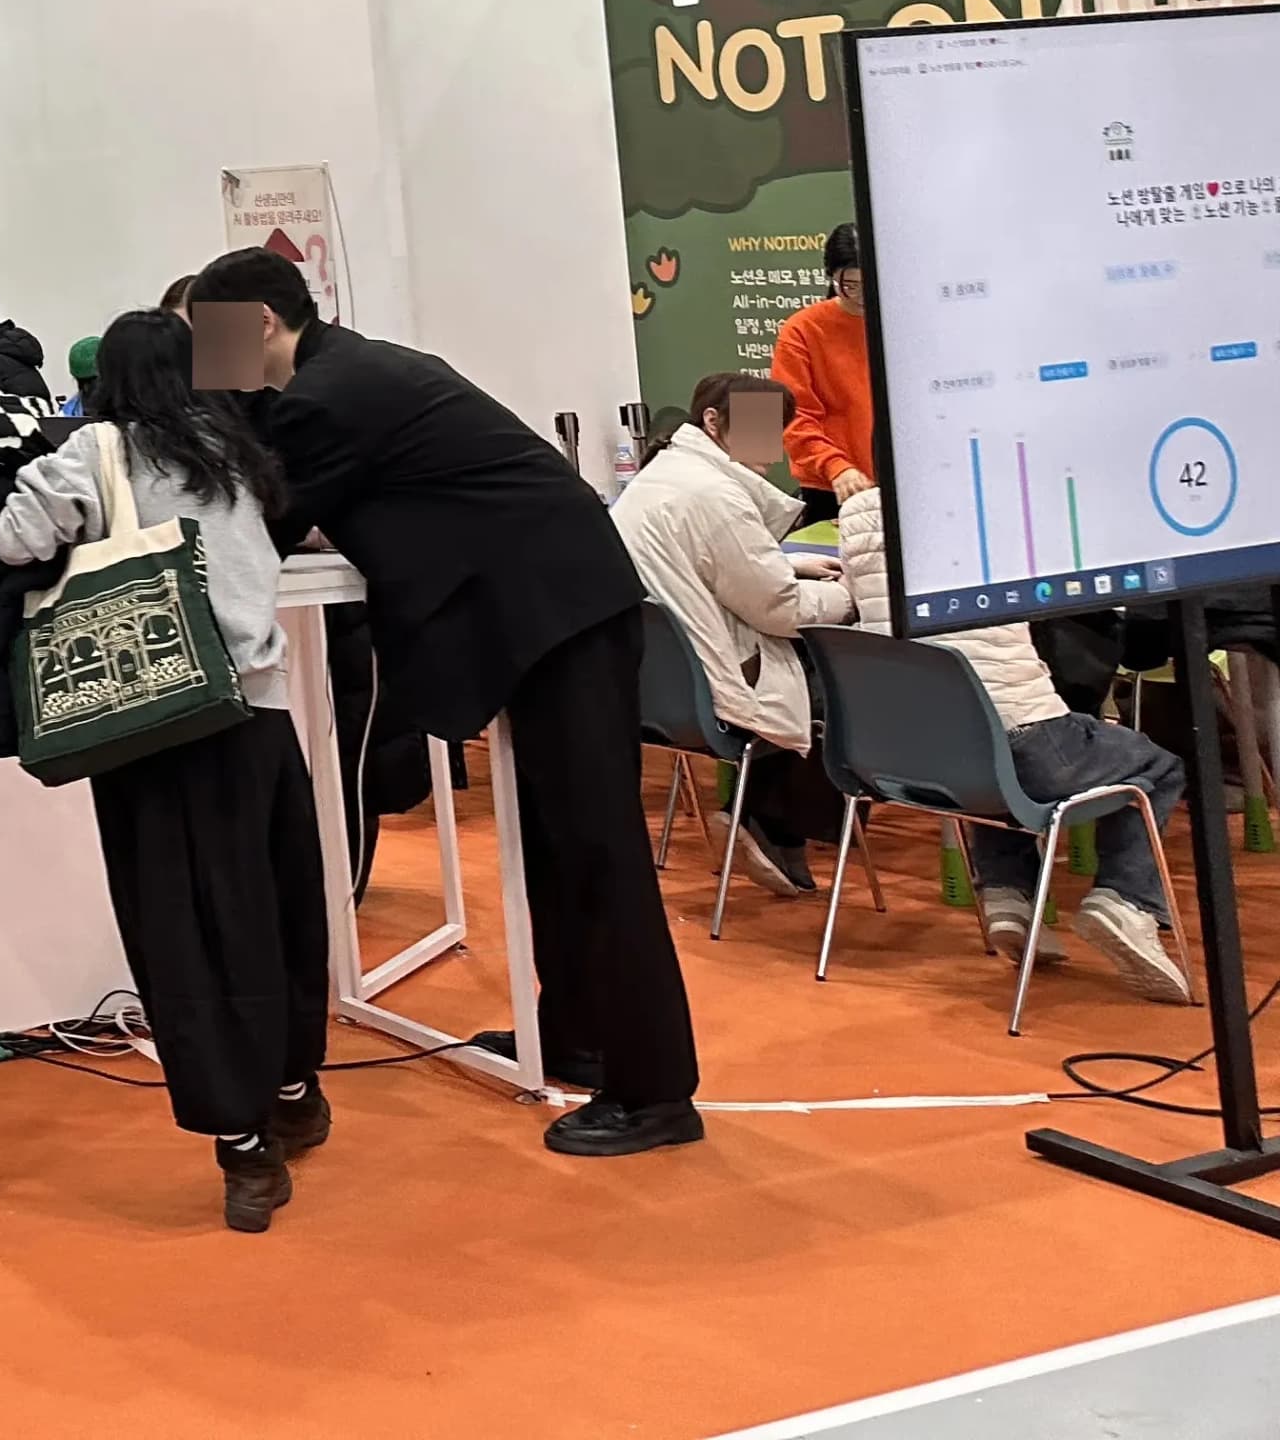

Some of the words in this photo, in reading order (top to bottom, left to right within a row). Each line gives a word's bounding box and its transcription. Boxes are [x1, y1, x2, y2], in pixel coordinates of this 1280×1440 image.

[1107, 189, 1135, 206] 노션
[1221, 180, 1247, 195] 으로
[1250, 176, 1275, 193] 나의
[1116, 207, 1156, 227] 나에게
[1160, 206, 1185, 224] 맞는
[1204, 202, 1230, 218] 노션
[1233, 199, 1259, 216] 기능
[728, 237, 762, 252] WHY
[764, 233, 827, 251] NOTION?
[730, 269, 767, 286] 노션은
[768, 269, 796, 287] 메모,
[733, 294, 800, 309] All-in-One
[734, 318, 763, 336] 일정,
[737, 343, 774, 359] 나만의
[1179, 461, 1208, 488] 42
